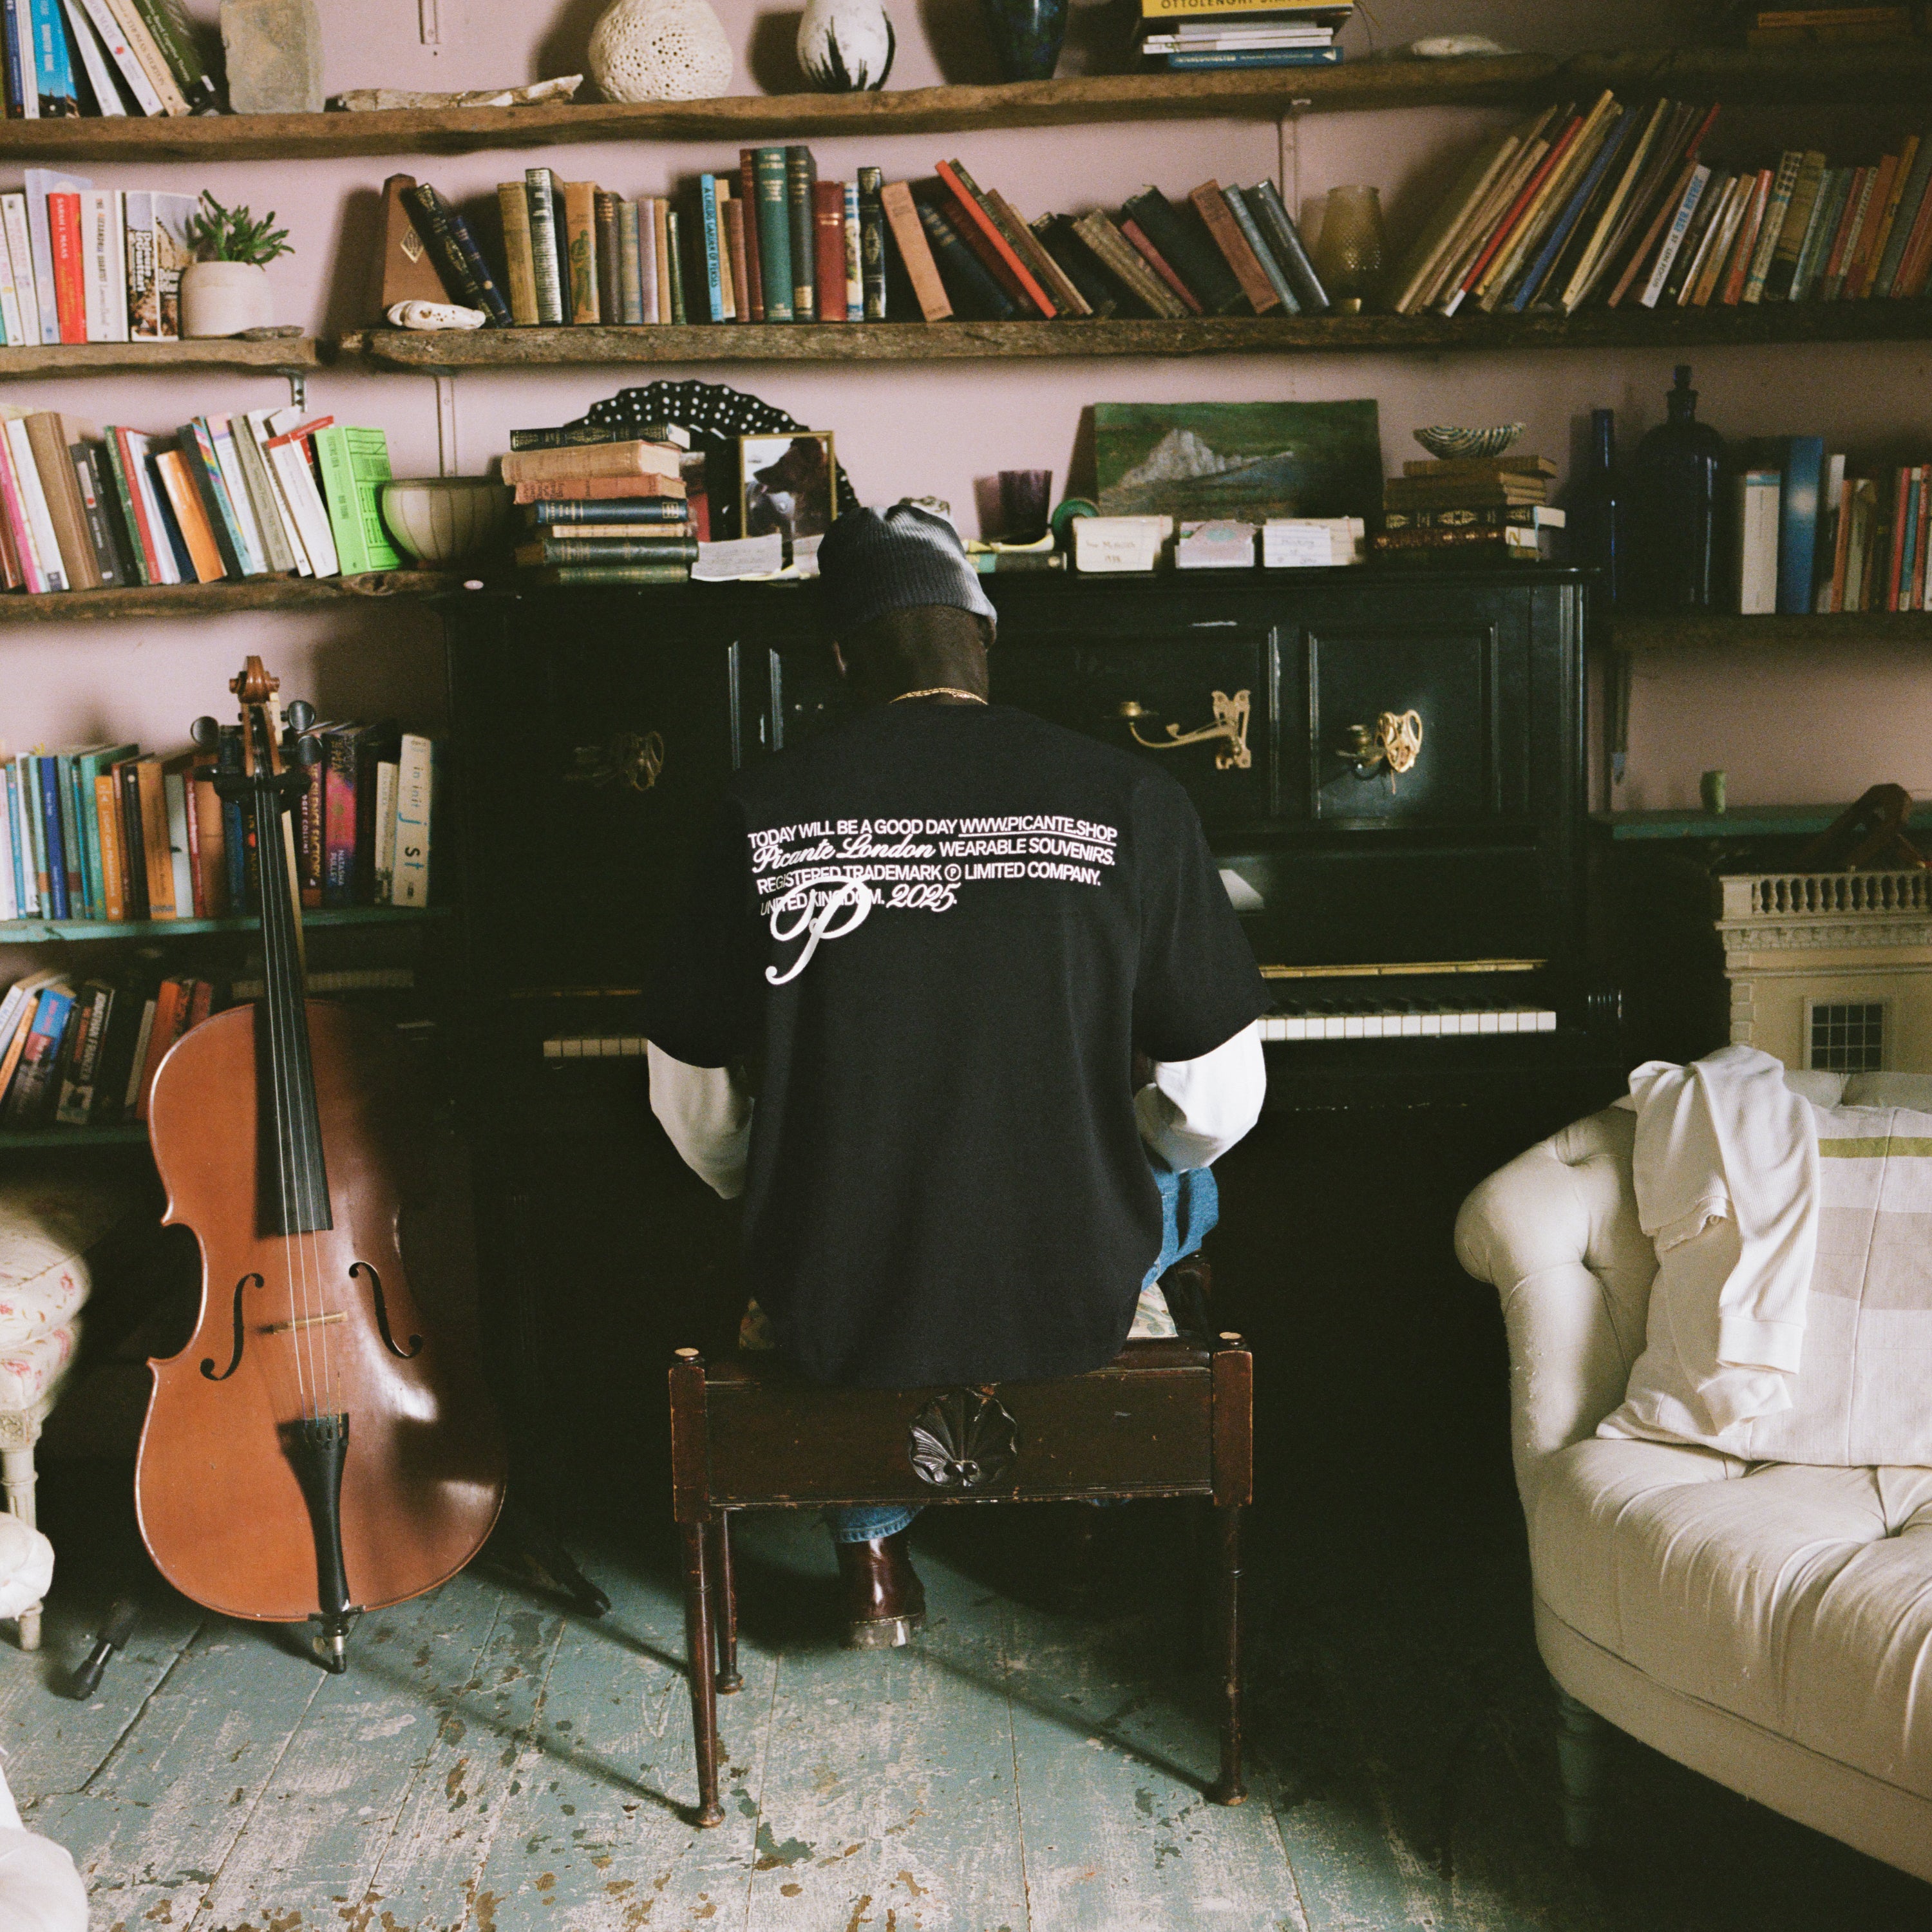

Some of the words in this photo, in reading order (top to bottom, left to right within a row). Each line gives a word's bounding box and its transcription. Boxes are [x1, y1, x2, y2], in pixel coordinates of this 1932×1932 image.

[310, 781, 320, 827] SILENCE
[748, 825, 797, 848] TODAY
[799, 820, 835, 838] WILL
[837, 820, 858, 835] BE
[860, 819, 872, 834] A
[874, 819, 923, 835] GOOD
[925, 819, 958, 835] DAY
[958, 815, 1118, 844] WWW.PICANTE.SHOP
[310, 829, 321, 878] FACTORY
[330, 851, 339, 883] PULLEY
[337, 849, 345, 886] NATASHA
[752, 838, 836, 873] Picante
[836, 833, 936, 858] London
[939, 838, 1027, 857] WEARABLE
[1028, 838, 1115, 866] SOUVENIRS.
[756, 866, 841, 895] REGISTERED
[843, 864, 942, 880] TRADEMARK
[965, 862, 1025, 880] LIMITED
[1027, 862, 1101, 886] COMPANY.
[761, 893, 808, 916] UNITED
[809, 889, 885, 907] KINDM.
[886, 883, 961, 912] 2025.
